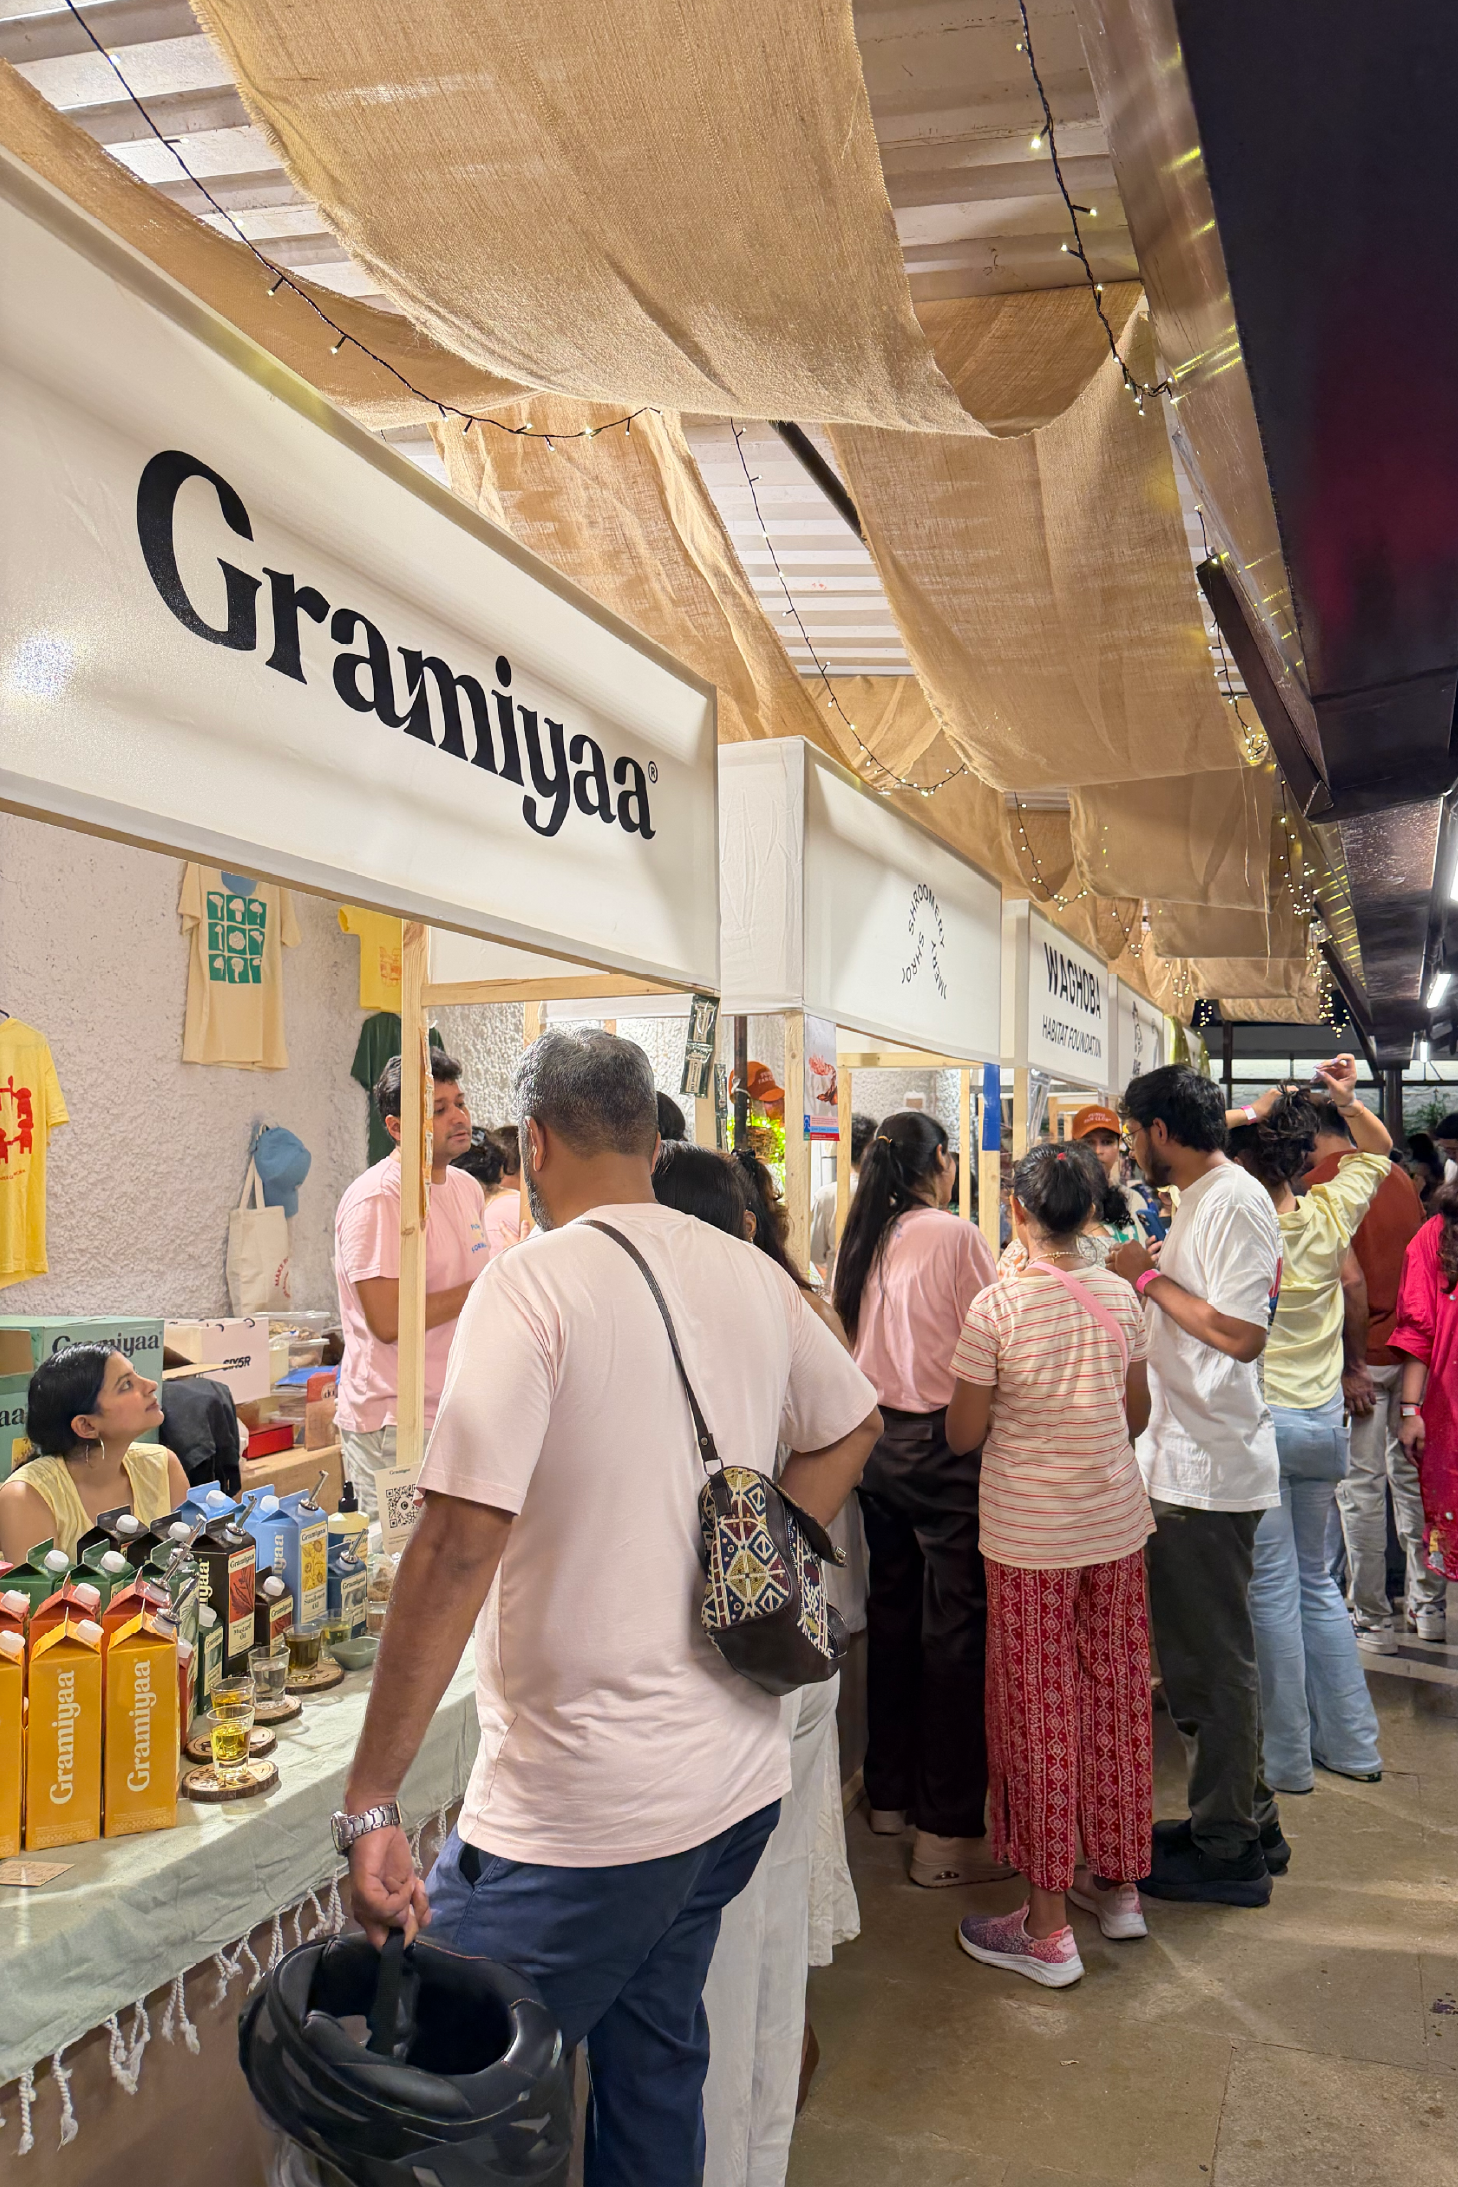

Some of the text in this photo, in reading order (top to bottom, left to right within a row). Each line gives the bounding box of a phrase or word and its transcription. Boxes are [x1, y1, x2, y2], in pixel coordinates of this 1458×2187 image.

[908, 883, 945, 948] SHROOMERY
[1043, 941, 1102, 1020] WAGHOBA
[1042, 1014, 1102, 1058] HABITAT FOUNDATION
[50, 1669, 81, 1805] Gramiyaa
[127, 1659, 157, 1793] Gramiyaa
